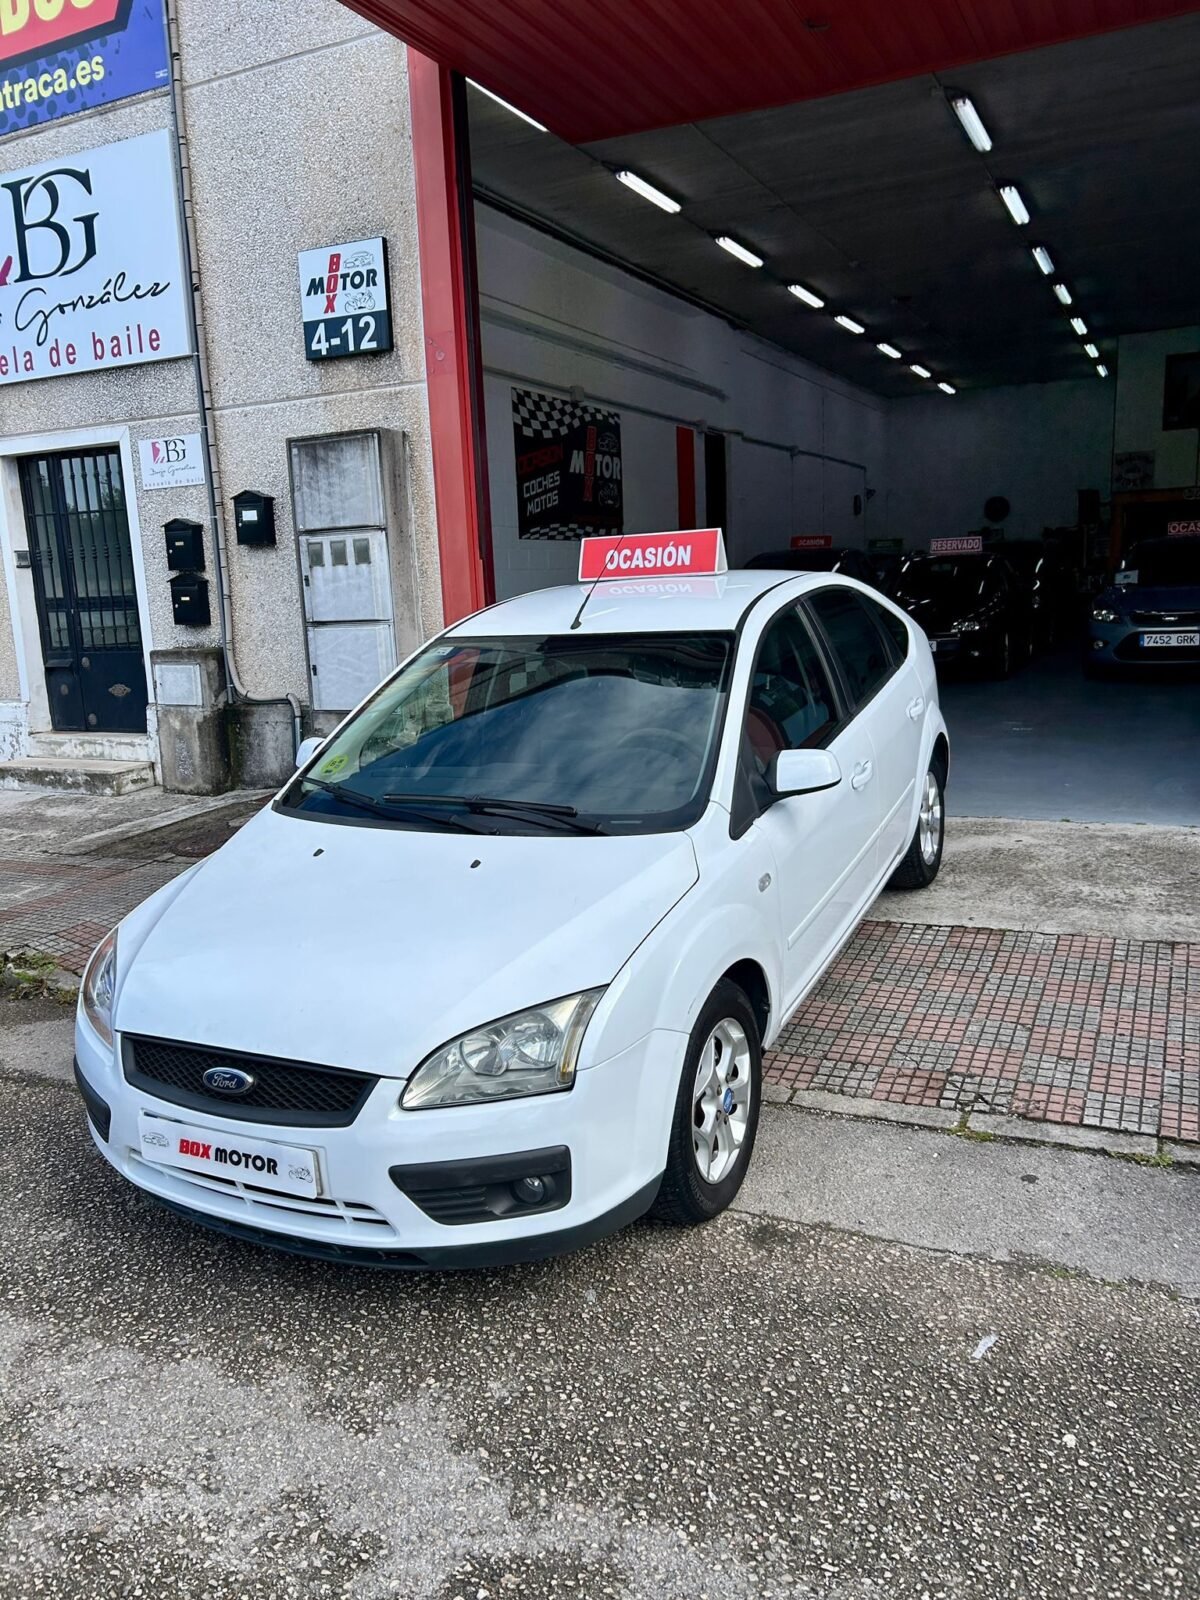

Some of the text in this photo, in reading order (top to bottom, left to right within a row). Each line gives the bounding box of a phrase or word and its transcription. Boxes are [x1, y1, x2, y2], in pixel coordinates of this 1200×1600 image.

[15, 271, 171, 347] González
[49, 338, 77, 368] de
[91, 323, 161, 361] baile
[311, 315, 378, 356] 4-12
[522, 469, 561, 499] COCHES
[526, 489, 560, 517] MOTOS
[605, 541, 692, 570] OCASIÓN
[931, 539, 979, 551] RESERVADO
[1146, 634, 1196, 645] 7452 GRK
[212, 1072, 238, 1088] Ford
[178, 1138, 279, 1176] BOX MOTOR
